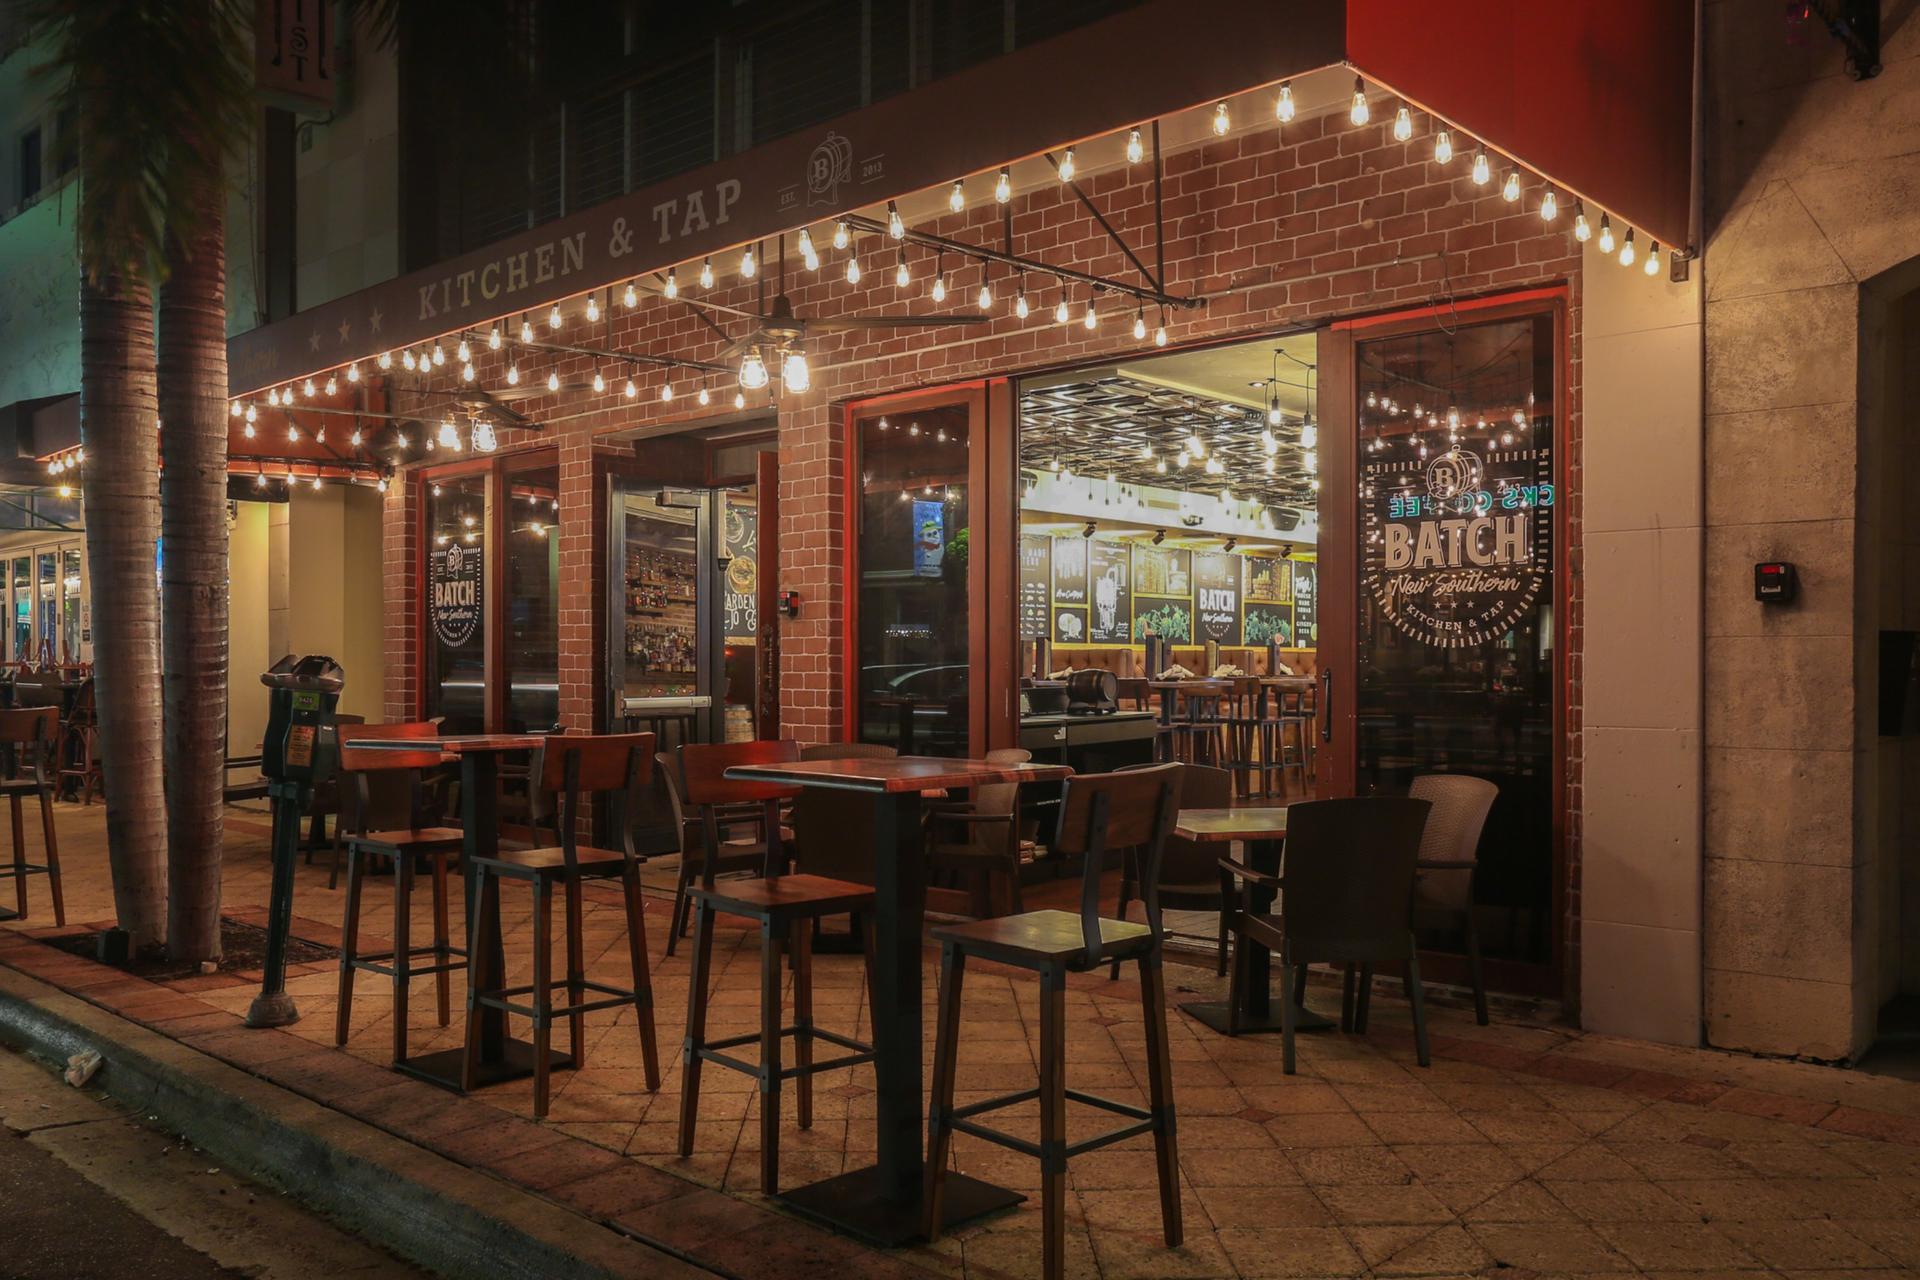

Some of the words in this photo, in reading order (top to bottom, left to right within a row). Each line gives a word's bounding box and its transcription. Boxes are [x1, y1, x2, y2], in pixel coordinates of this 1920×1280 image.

[862, 161, 883, 177] 2013
[780, 191, 796, 205] EST.
[418, 231, 586, 321] KITCHEN
[608, 217, 633, 258] &
[652, 178, 742, 244] TAP
[1384, 515, 1528, 570] BATCH
[435, 580, 476, 608] BATCH
[1391, 574, 1433, 596] New
[1432, 571, 1521, 597] Southern
[725, 593, 755, 610] ARDEN
[1199, 588, 1235, 613] BATCH
[1406, 604, 1462, 631] KITCHEN
[1469, 618, 1478, 628] &
[1481, 600, 1504, 621] TAP
